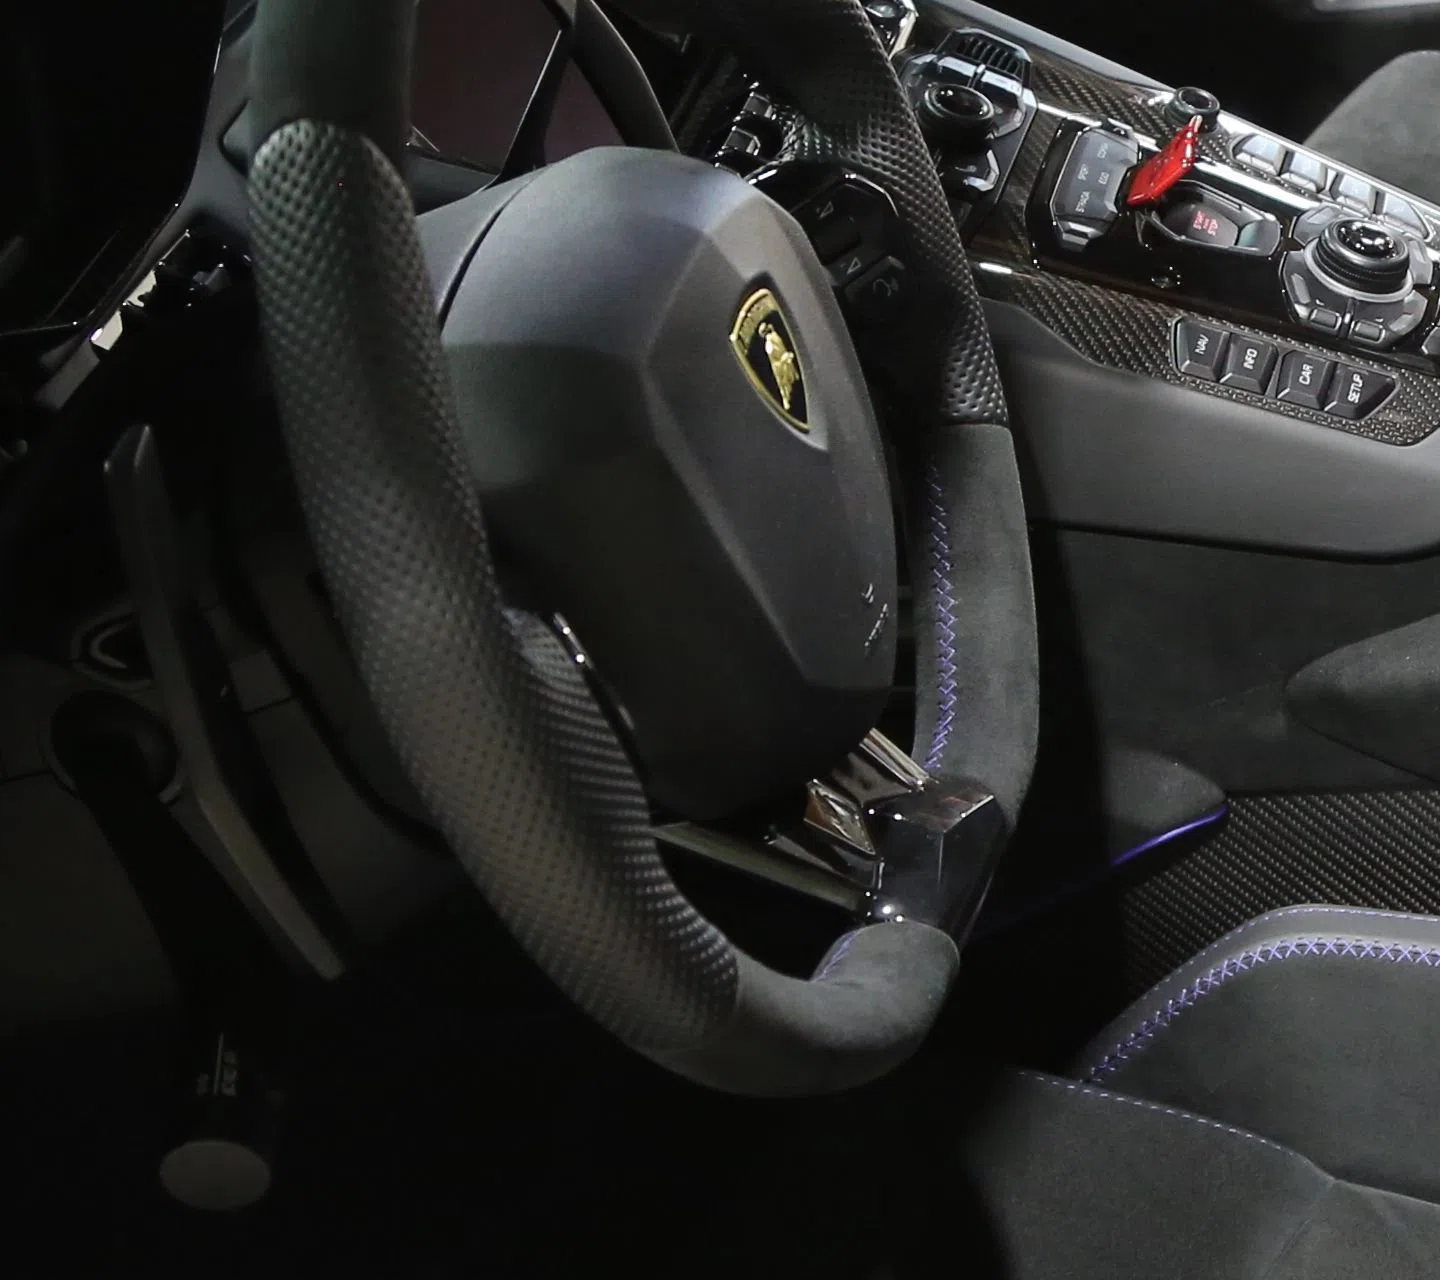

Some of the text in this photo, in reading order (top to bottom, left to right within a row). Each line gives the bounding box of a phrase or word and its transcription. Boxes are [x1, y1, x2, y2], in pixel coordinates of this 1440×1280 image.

[1195, 334, 1209, 355] NAV
[1243, 348, 1258, 370] INFO
[1299, 364, 1313, 385] CAR
[1347, 374, 1363, 404] SETUP
